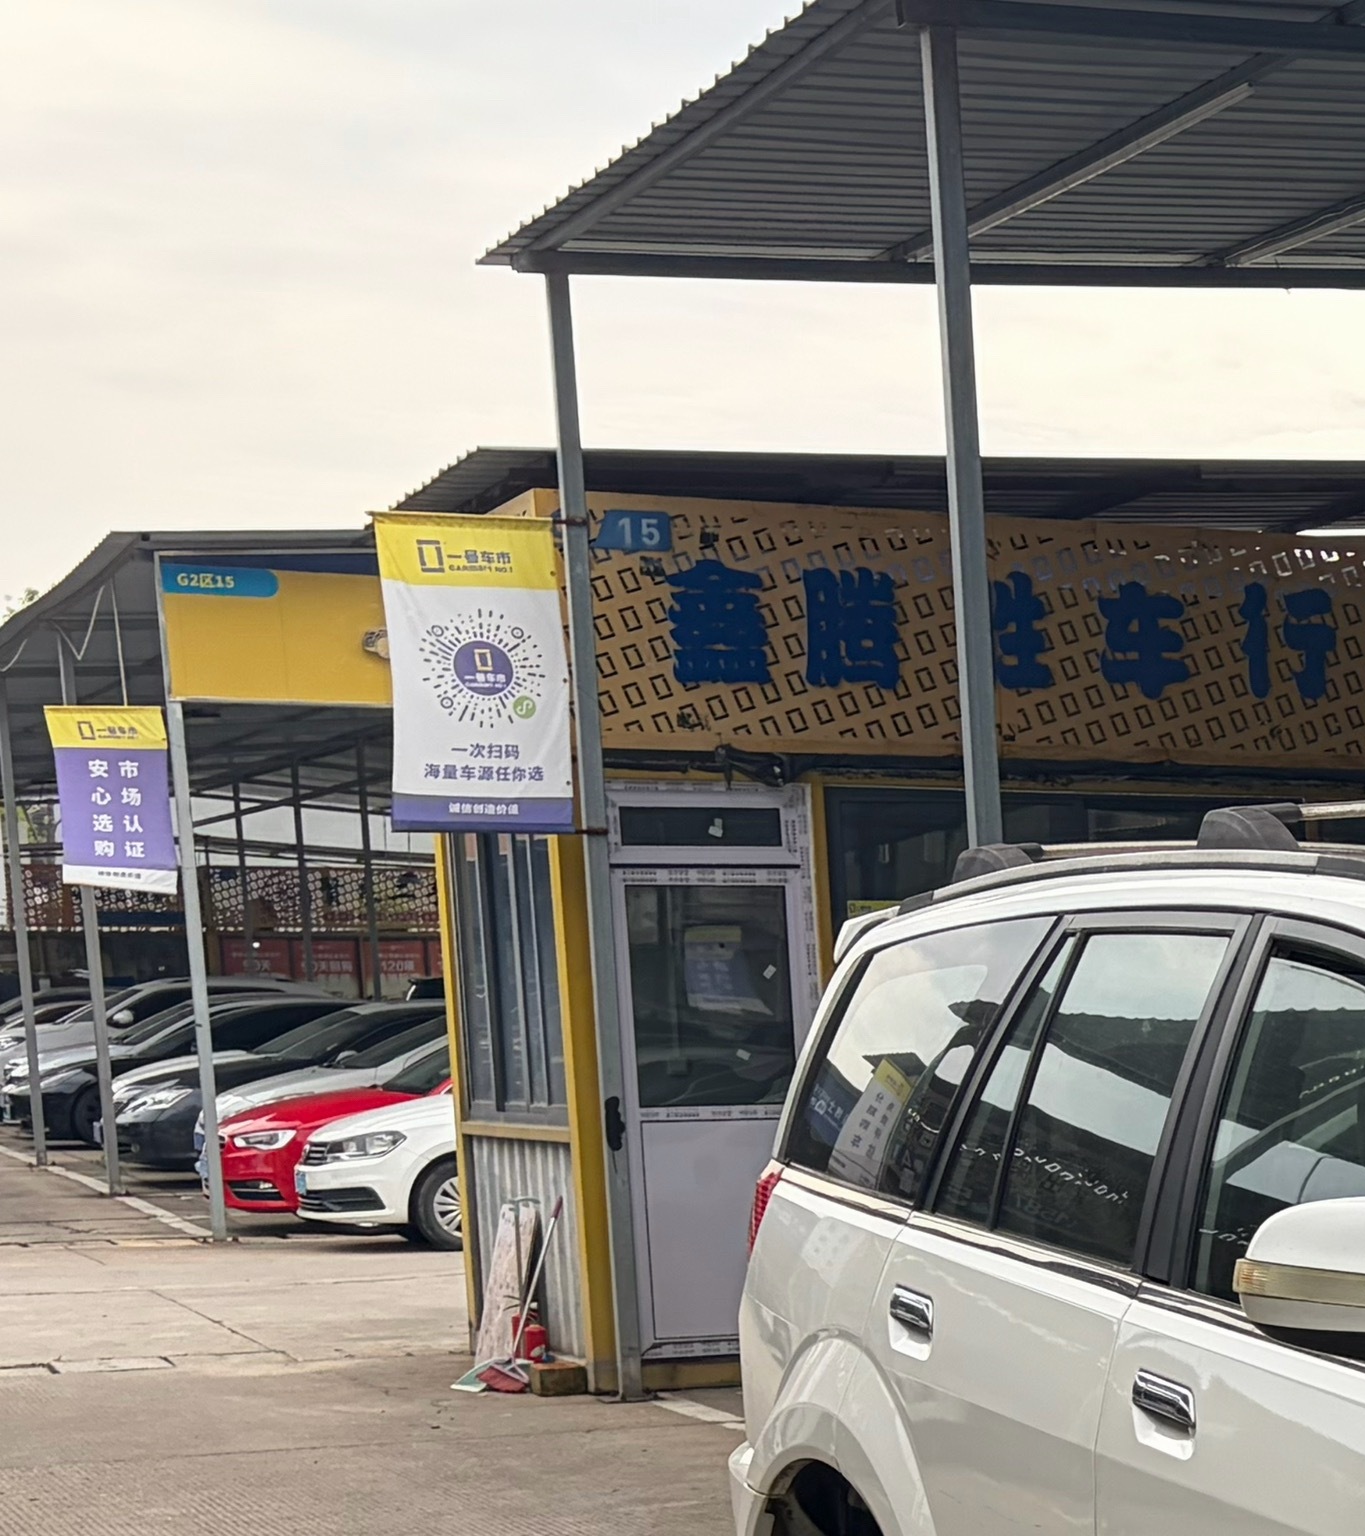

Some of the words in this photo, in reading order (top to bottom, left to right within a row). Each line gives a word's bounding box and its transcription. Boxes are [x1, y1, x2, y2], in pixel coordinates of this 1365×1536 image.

[617, 517, 661, 547] 15
[447, 549, 511, 564] 一号车市
[177, 573, 234, 589] G2区15
[451, 743, 520, 759] 一次扫码
[424, 764, 544, 782] 海量车源任你选
[88, 759, 115, 858] 安心选购
[118, 760, 145, 858] 市场认证
